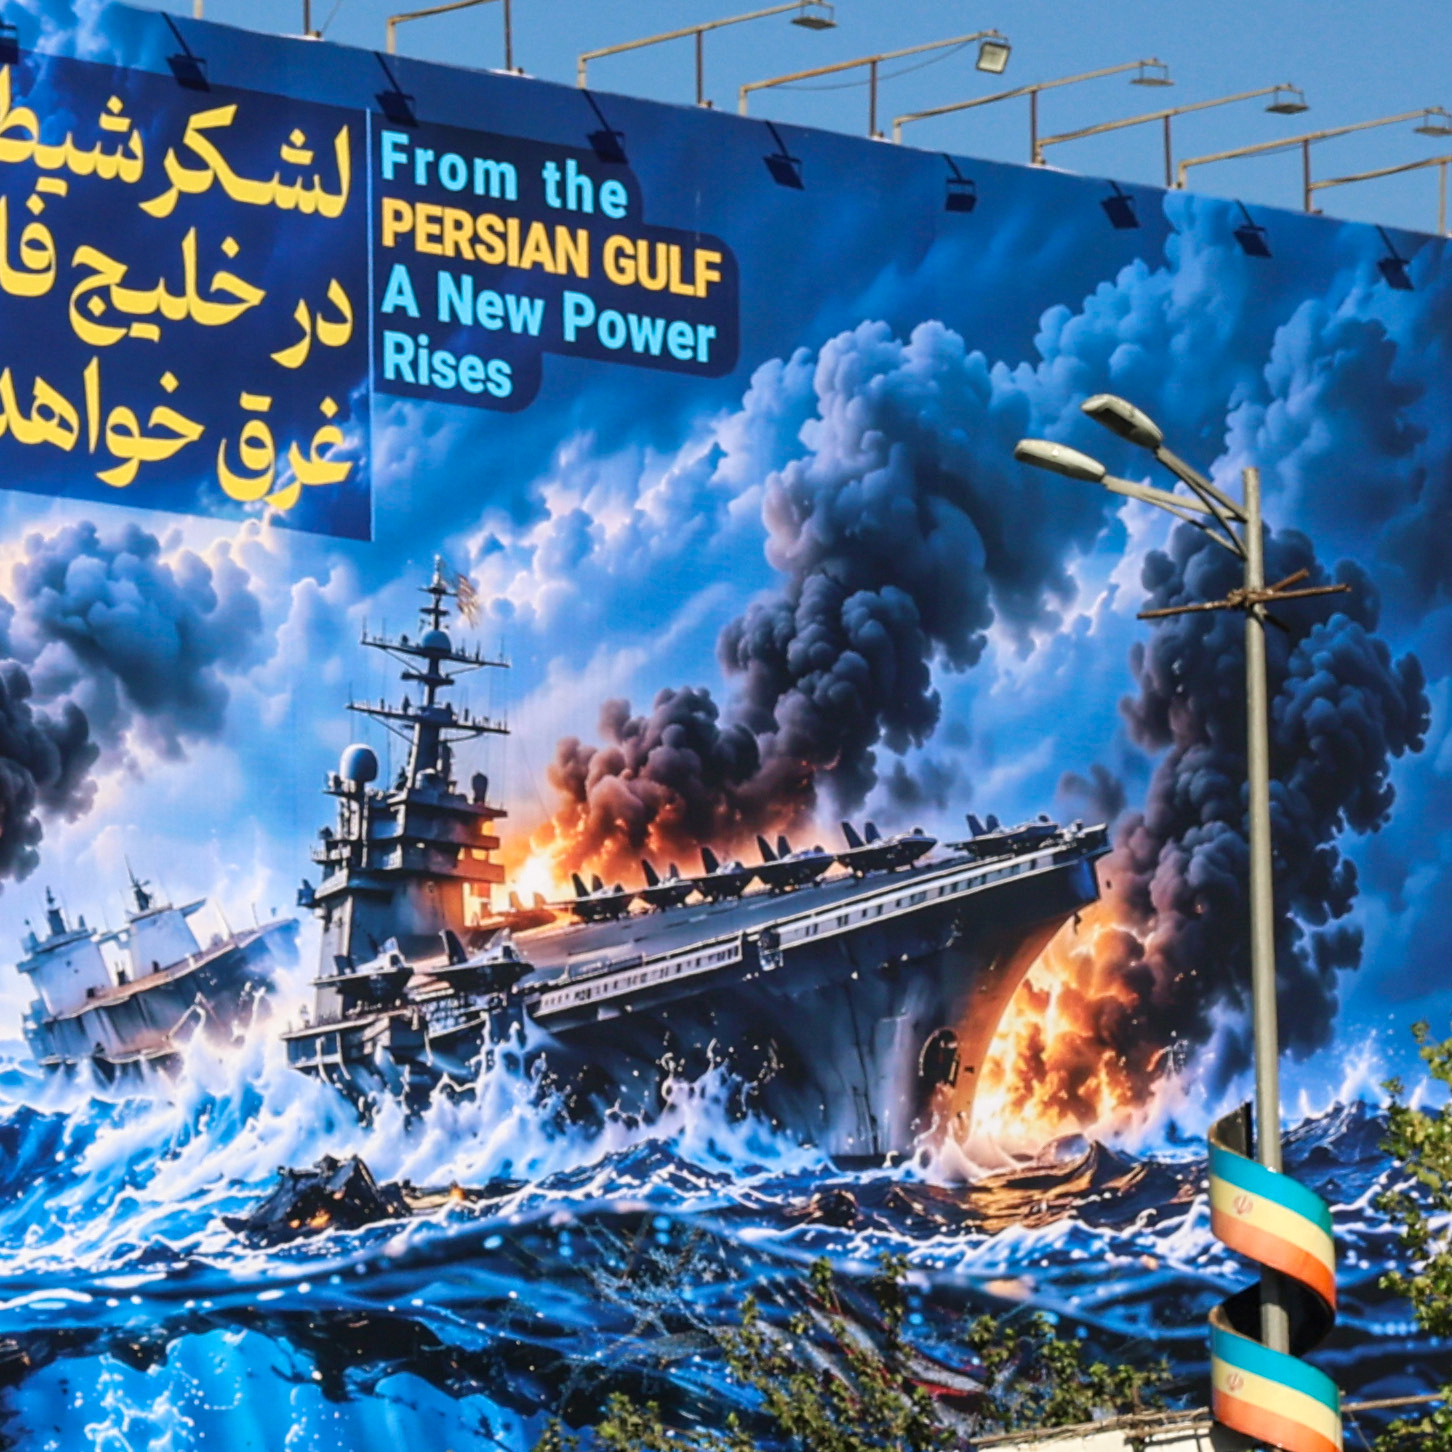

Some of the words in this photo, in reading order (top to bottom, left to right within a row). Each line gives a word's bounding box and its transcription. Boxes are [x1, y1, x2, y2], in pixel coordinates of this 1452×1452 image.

[139, 104, 351, 218] لشکر
[381, 130, 518, 201] From
[541, 158, 628, 219] the
[69, 228, 266, 347] خلیج
[381, 196, 589, 279] PERSIAN
[603, 234, 722, 298] GULF
[270, 279, 353, 369] در
[381, 263, 420, 318] A
[437, 270, 545, 337] New
[562, 290, 716, 363] Power
[383, 330, 513, 398] Rises
[217, 391, 353, 510] غرق
